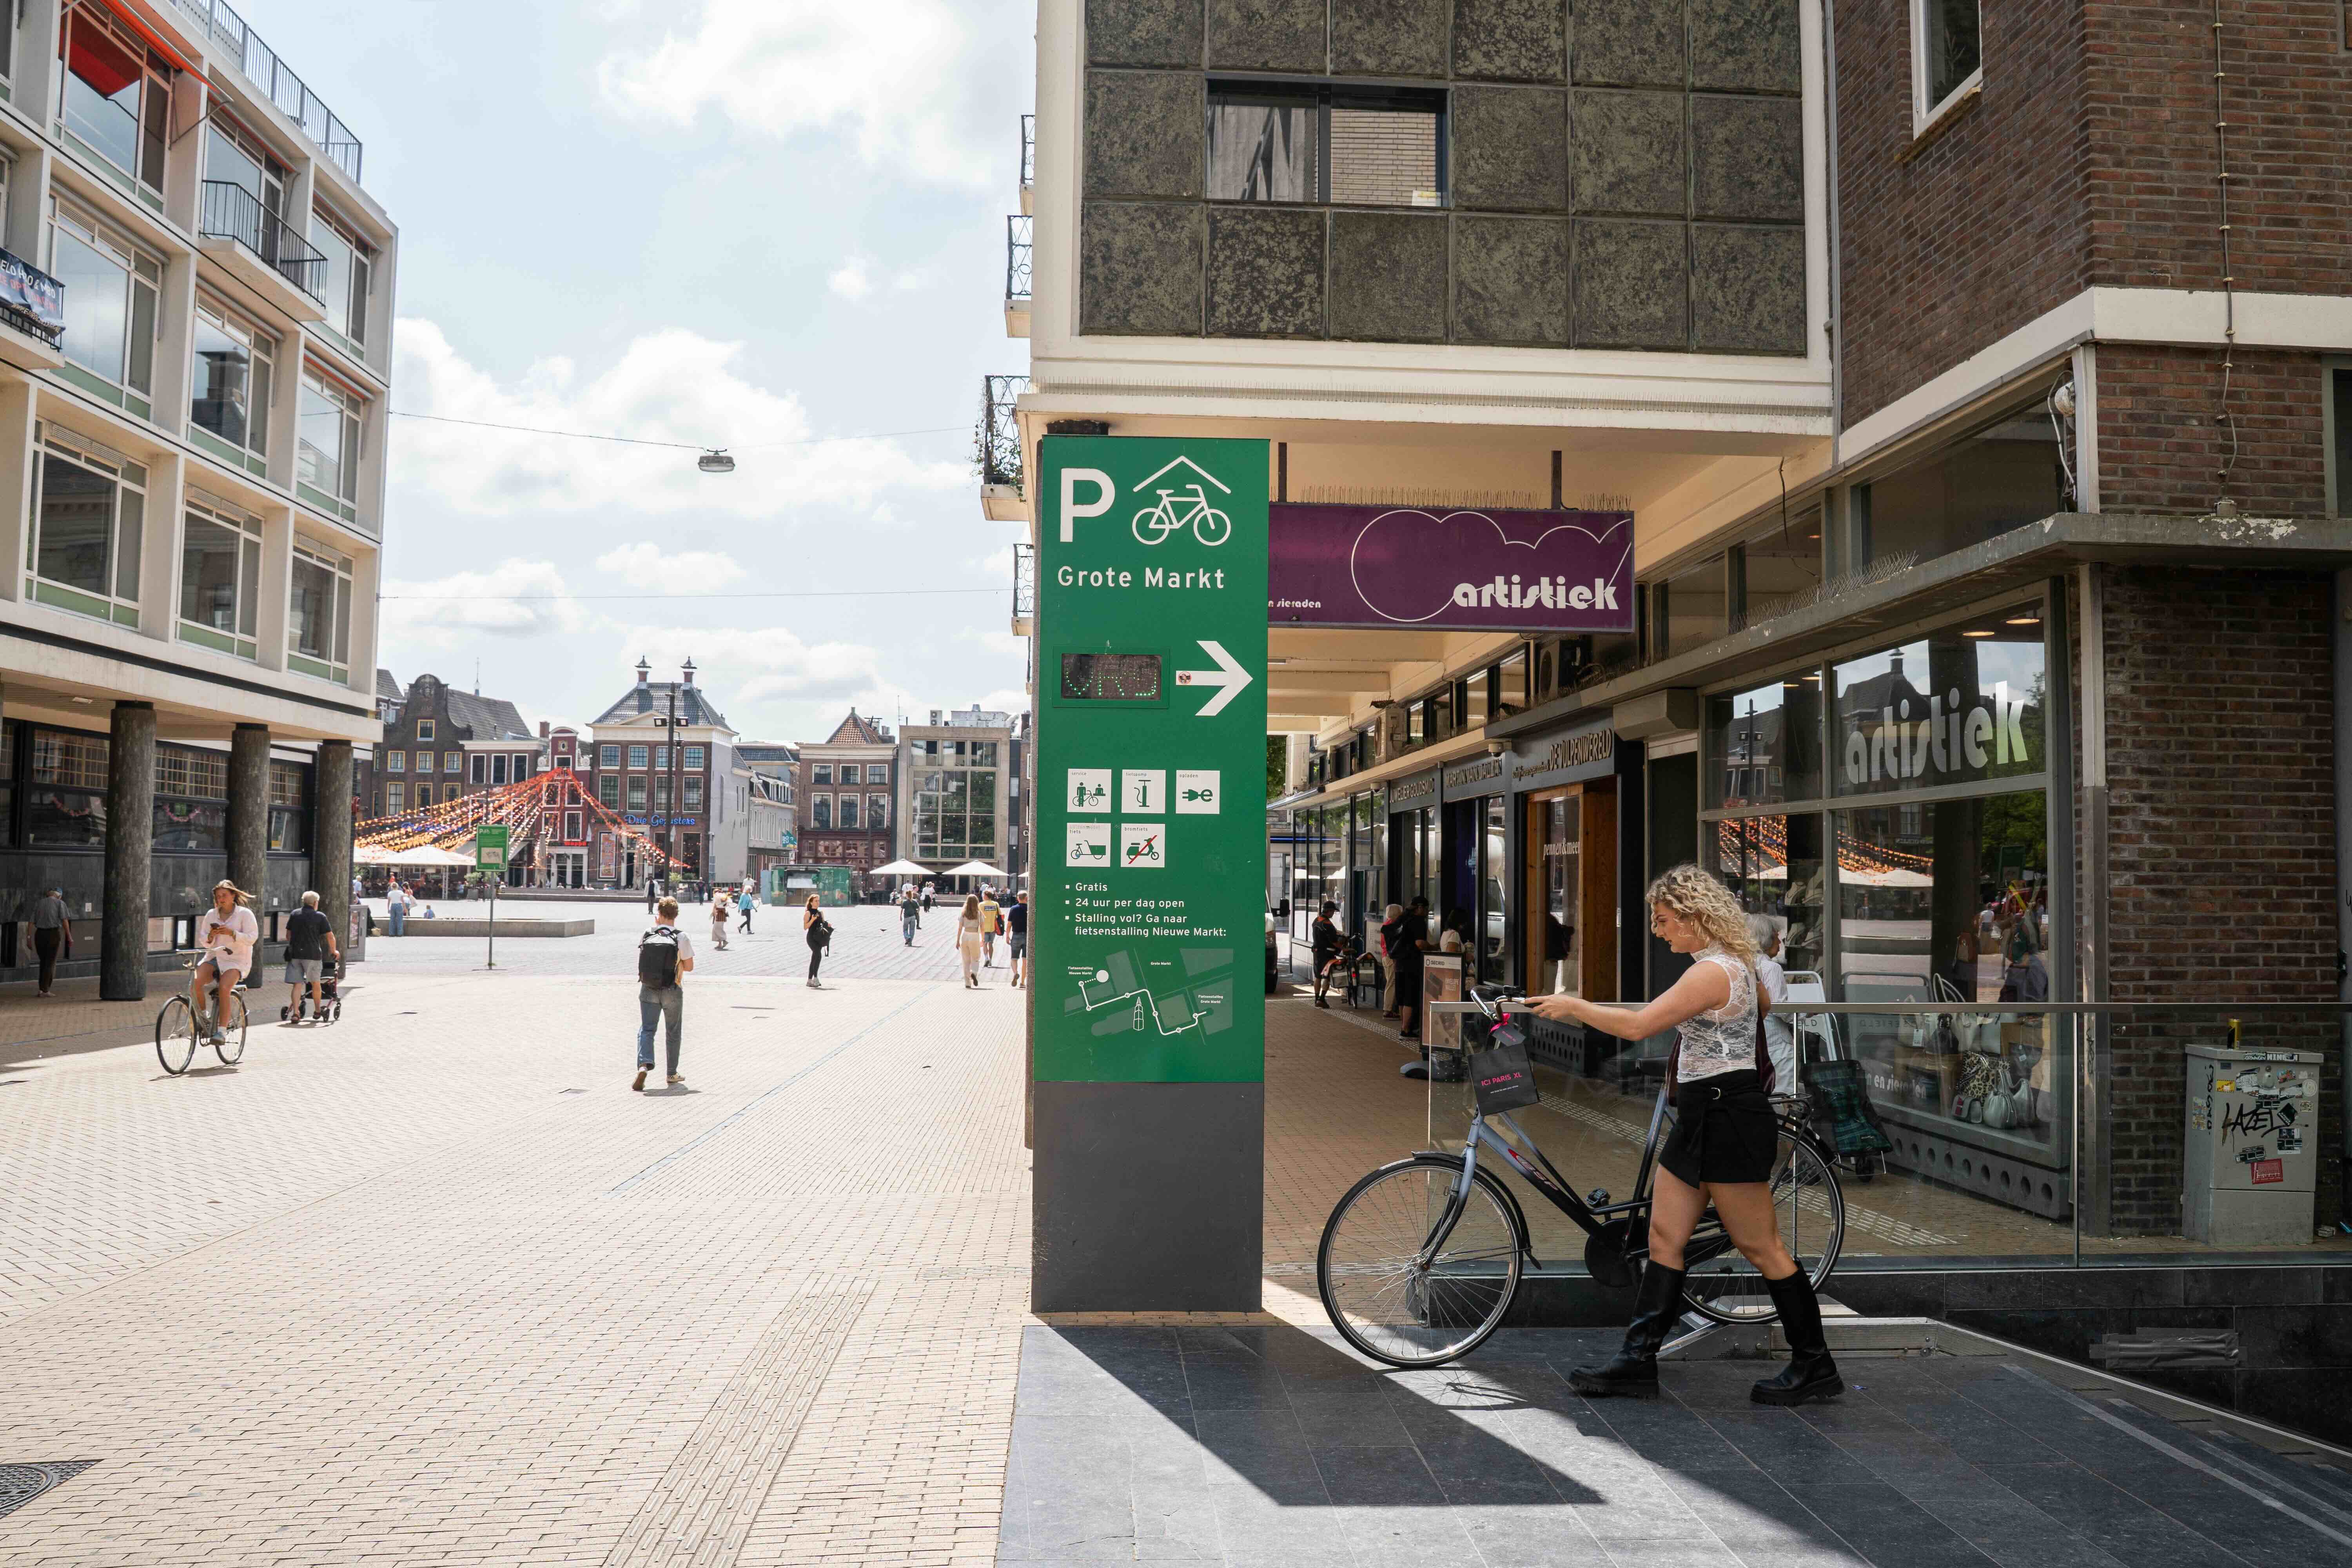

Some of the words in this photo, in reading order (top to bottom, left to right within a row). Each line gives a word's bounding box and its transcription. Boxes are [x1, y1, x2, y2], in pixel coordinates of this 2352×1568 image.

[1060, 468, 1116, 543] P
[1058, 566, 1132, 588] Grote
[1145, 567, 1225, 589] Markt
[1454, 574, 1619, 610] artistiek
[1277, 598, 1321, 608] sieraden
[1845, 681, 2029, 784] artistiek
[1075, 882, 1108, 891] Gratis
[1075, 898, 1089, 907] 24
[1114, 900, 1132, 909] per
[1136, 898, 1155, 909] dag
[1159, 900, 1185, 910] open
[1075, 913, 1116, 925] Stalling
[1120, 913, 1141, 923] vol?
[1146, 914, 1160, 923] Ga
[1075, 927, 1149, 938] fietsenstalling
[1152, 927, 1190, 936] Nieuwe
[1193, 927, 1227, 936] Markt:
[1481, 1078, 1491, 1087] ICI
[1492, 1074, 1512, 1084] PARIS
